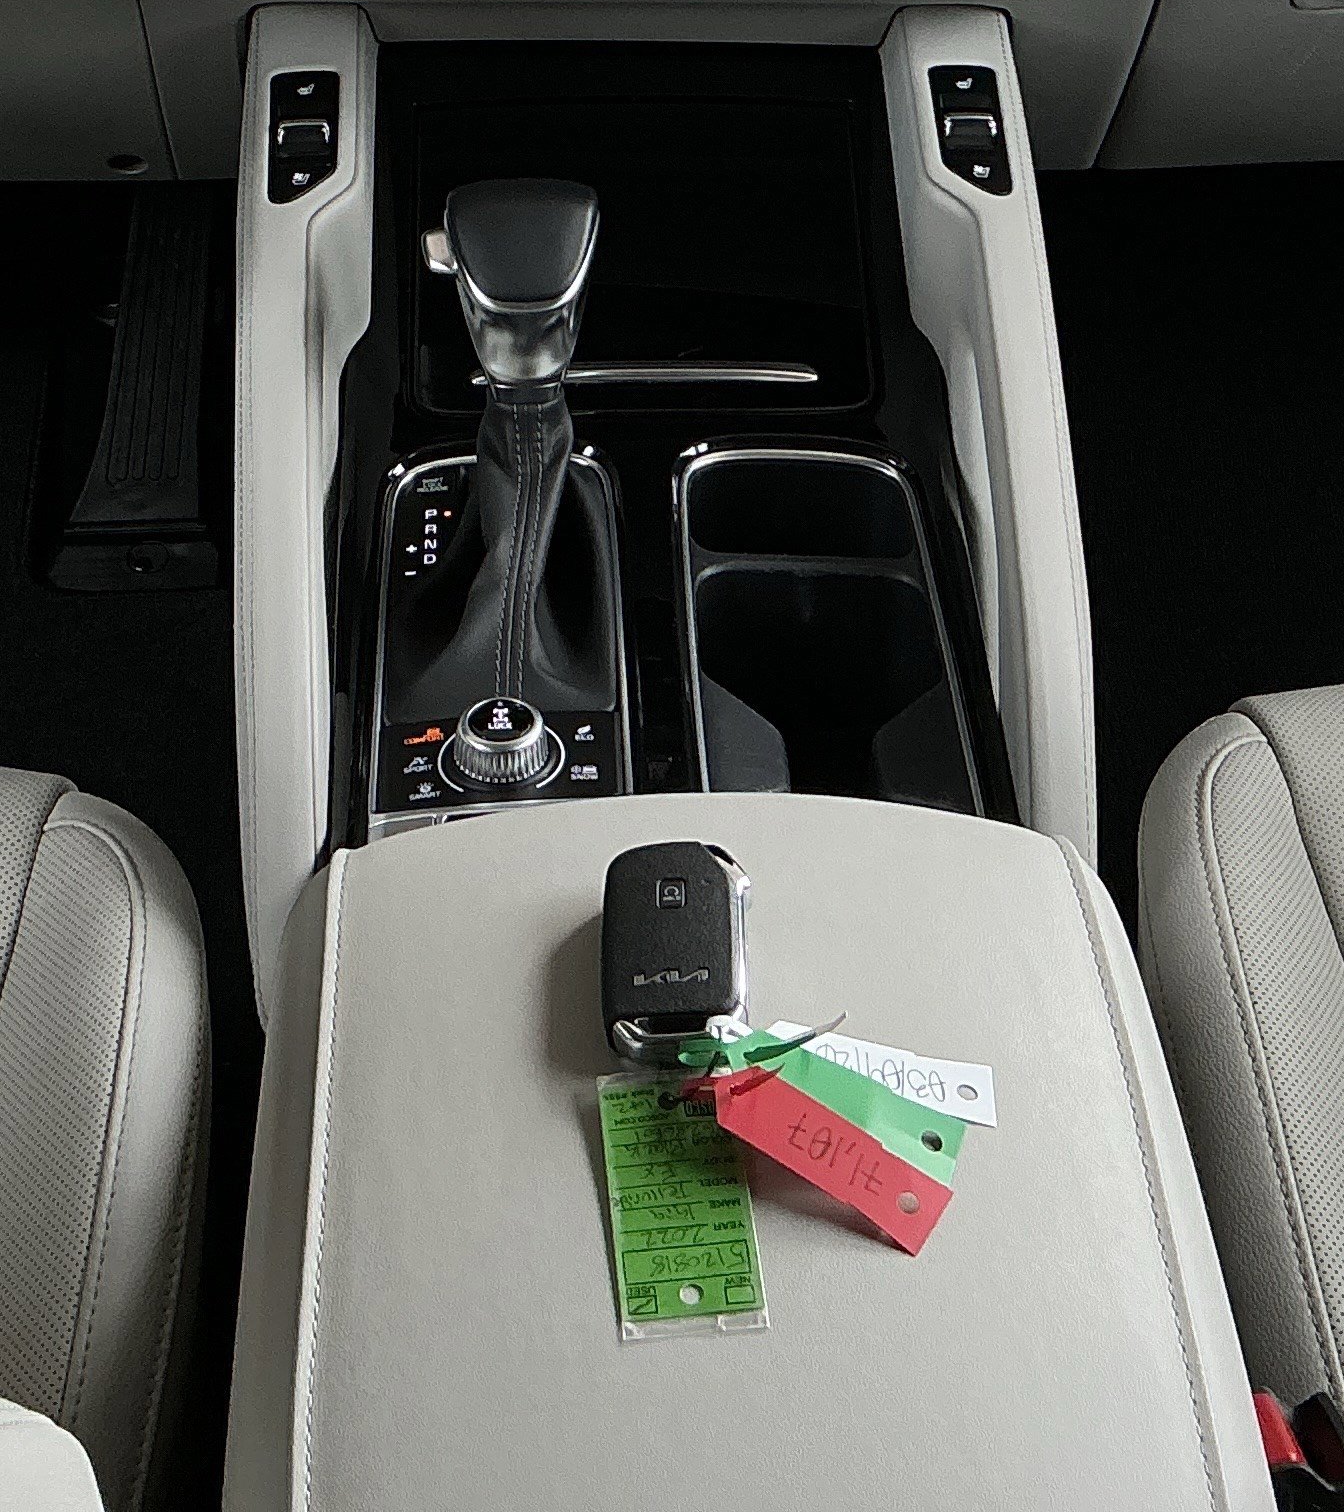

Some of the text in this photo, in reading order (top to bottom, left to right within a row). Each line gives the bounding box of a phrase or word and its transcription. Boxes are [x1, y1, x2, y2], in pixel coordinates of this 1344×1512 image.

[424, 508, 438, 520] P
[424, 523, 438, 535] R
[423, 538, 437, 550] N
[423, 553, 437, 565] D
[487, 721, 513, 730] LOCK
[403, 733, 444, 745] COMFORT
[403, 763, 434, 775] SPORT
[408, 789, 442, 802] SMART
[696, 1176, 739, 1188] MODEL
[707, 1197, 742, 1209] MAKE
[712, 1219, 745, 1231] YEAR
[724, 1275, 752, 1286] NEW
